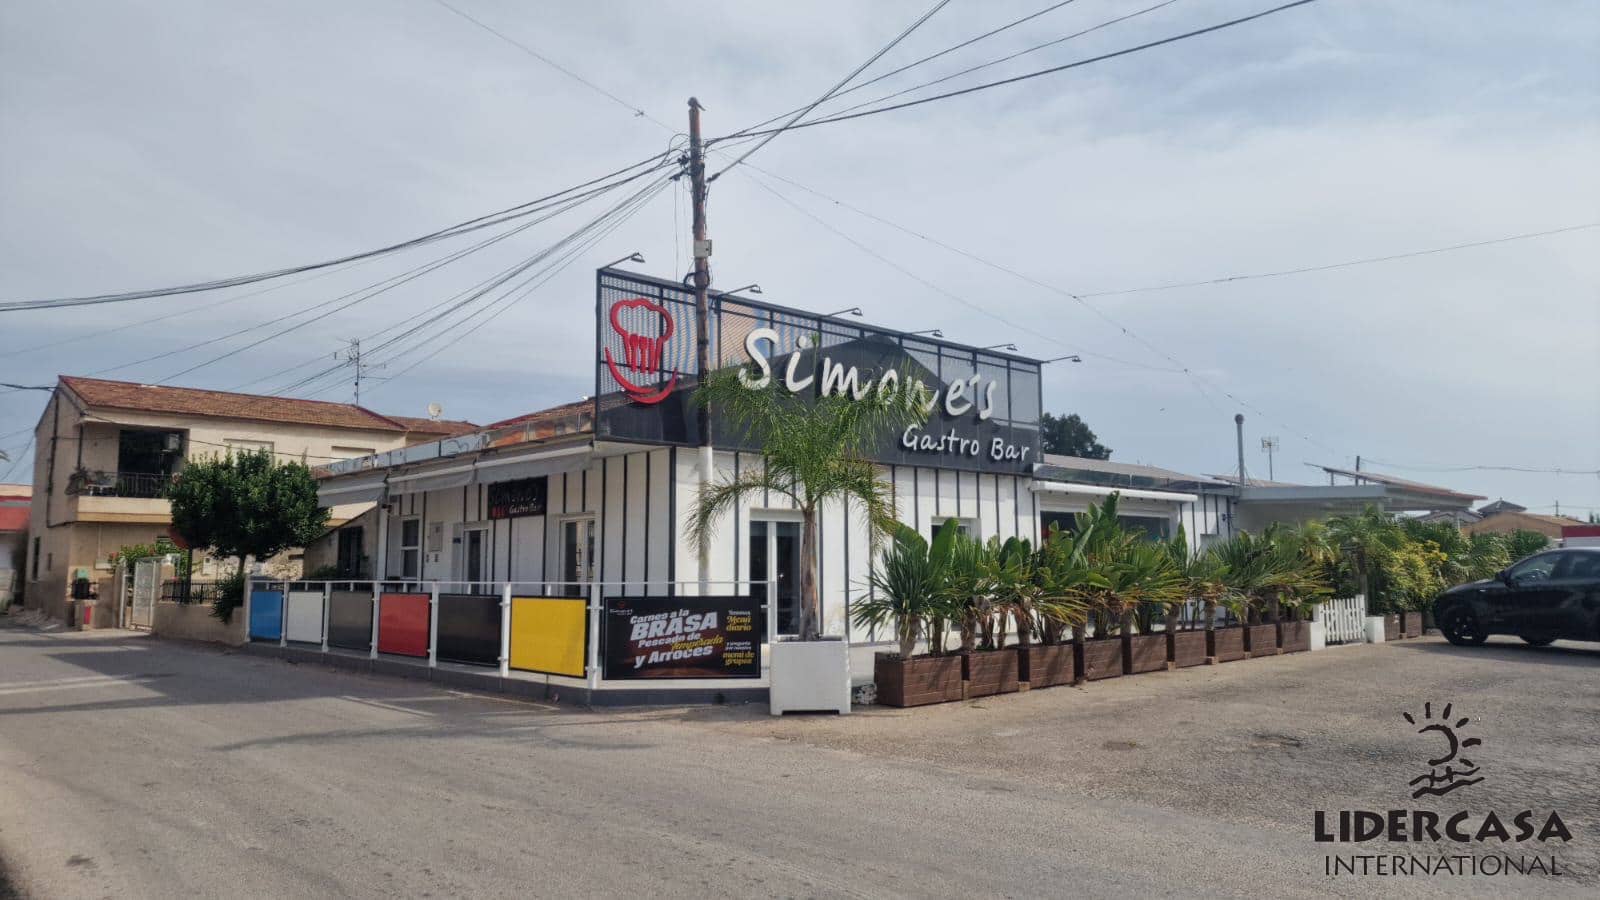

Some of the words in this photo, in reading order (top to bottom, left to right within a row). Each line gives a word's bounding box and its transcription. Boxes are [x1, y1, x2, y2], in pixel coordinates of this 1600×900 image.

[739, 327, 998, 421] Simone's
[902, 423, 980, 456] Gastro
[990, 437, 1030, 461] Bar
[630, 613, 669, 624] Carnes
[670, 611, 678, 619] a
[679, 608, 690, 617] la
[630, 612, 718, 641] BRASA
[726, 623, 752, 632] diario
[637, 634, 686, 649] Pescado
[687, 631, 702, 641] de
[633, 655, 645, 669] y
[649, 645, 714, 664] Arroces
